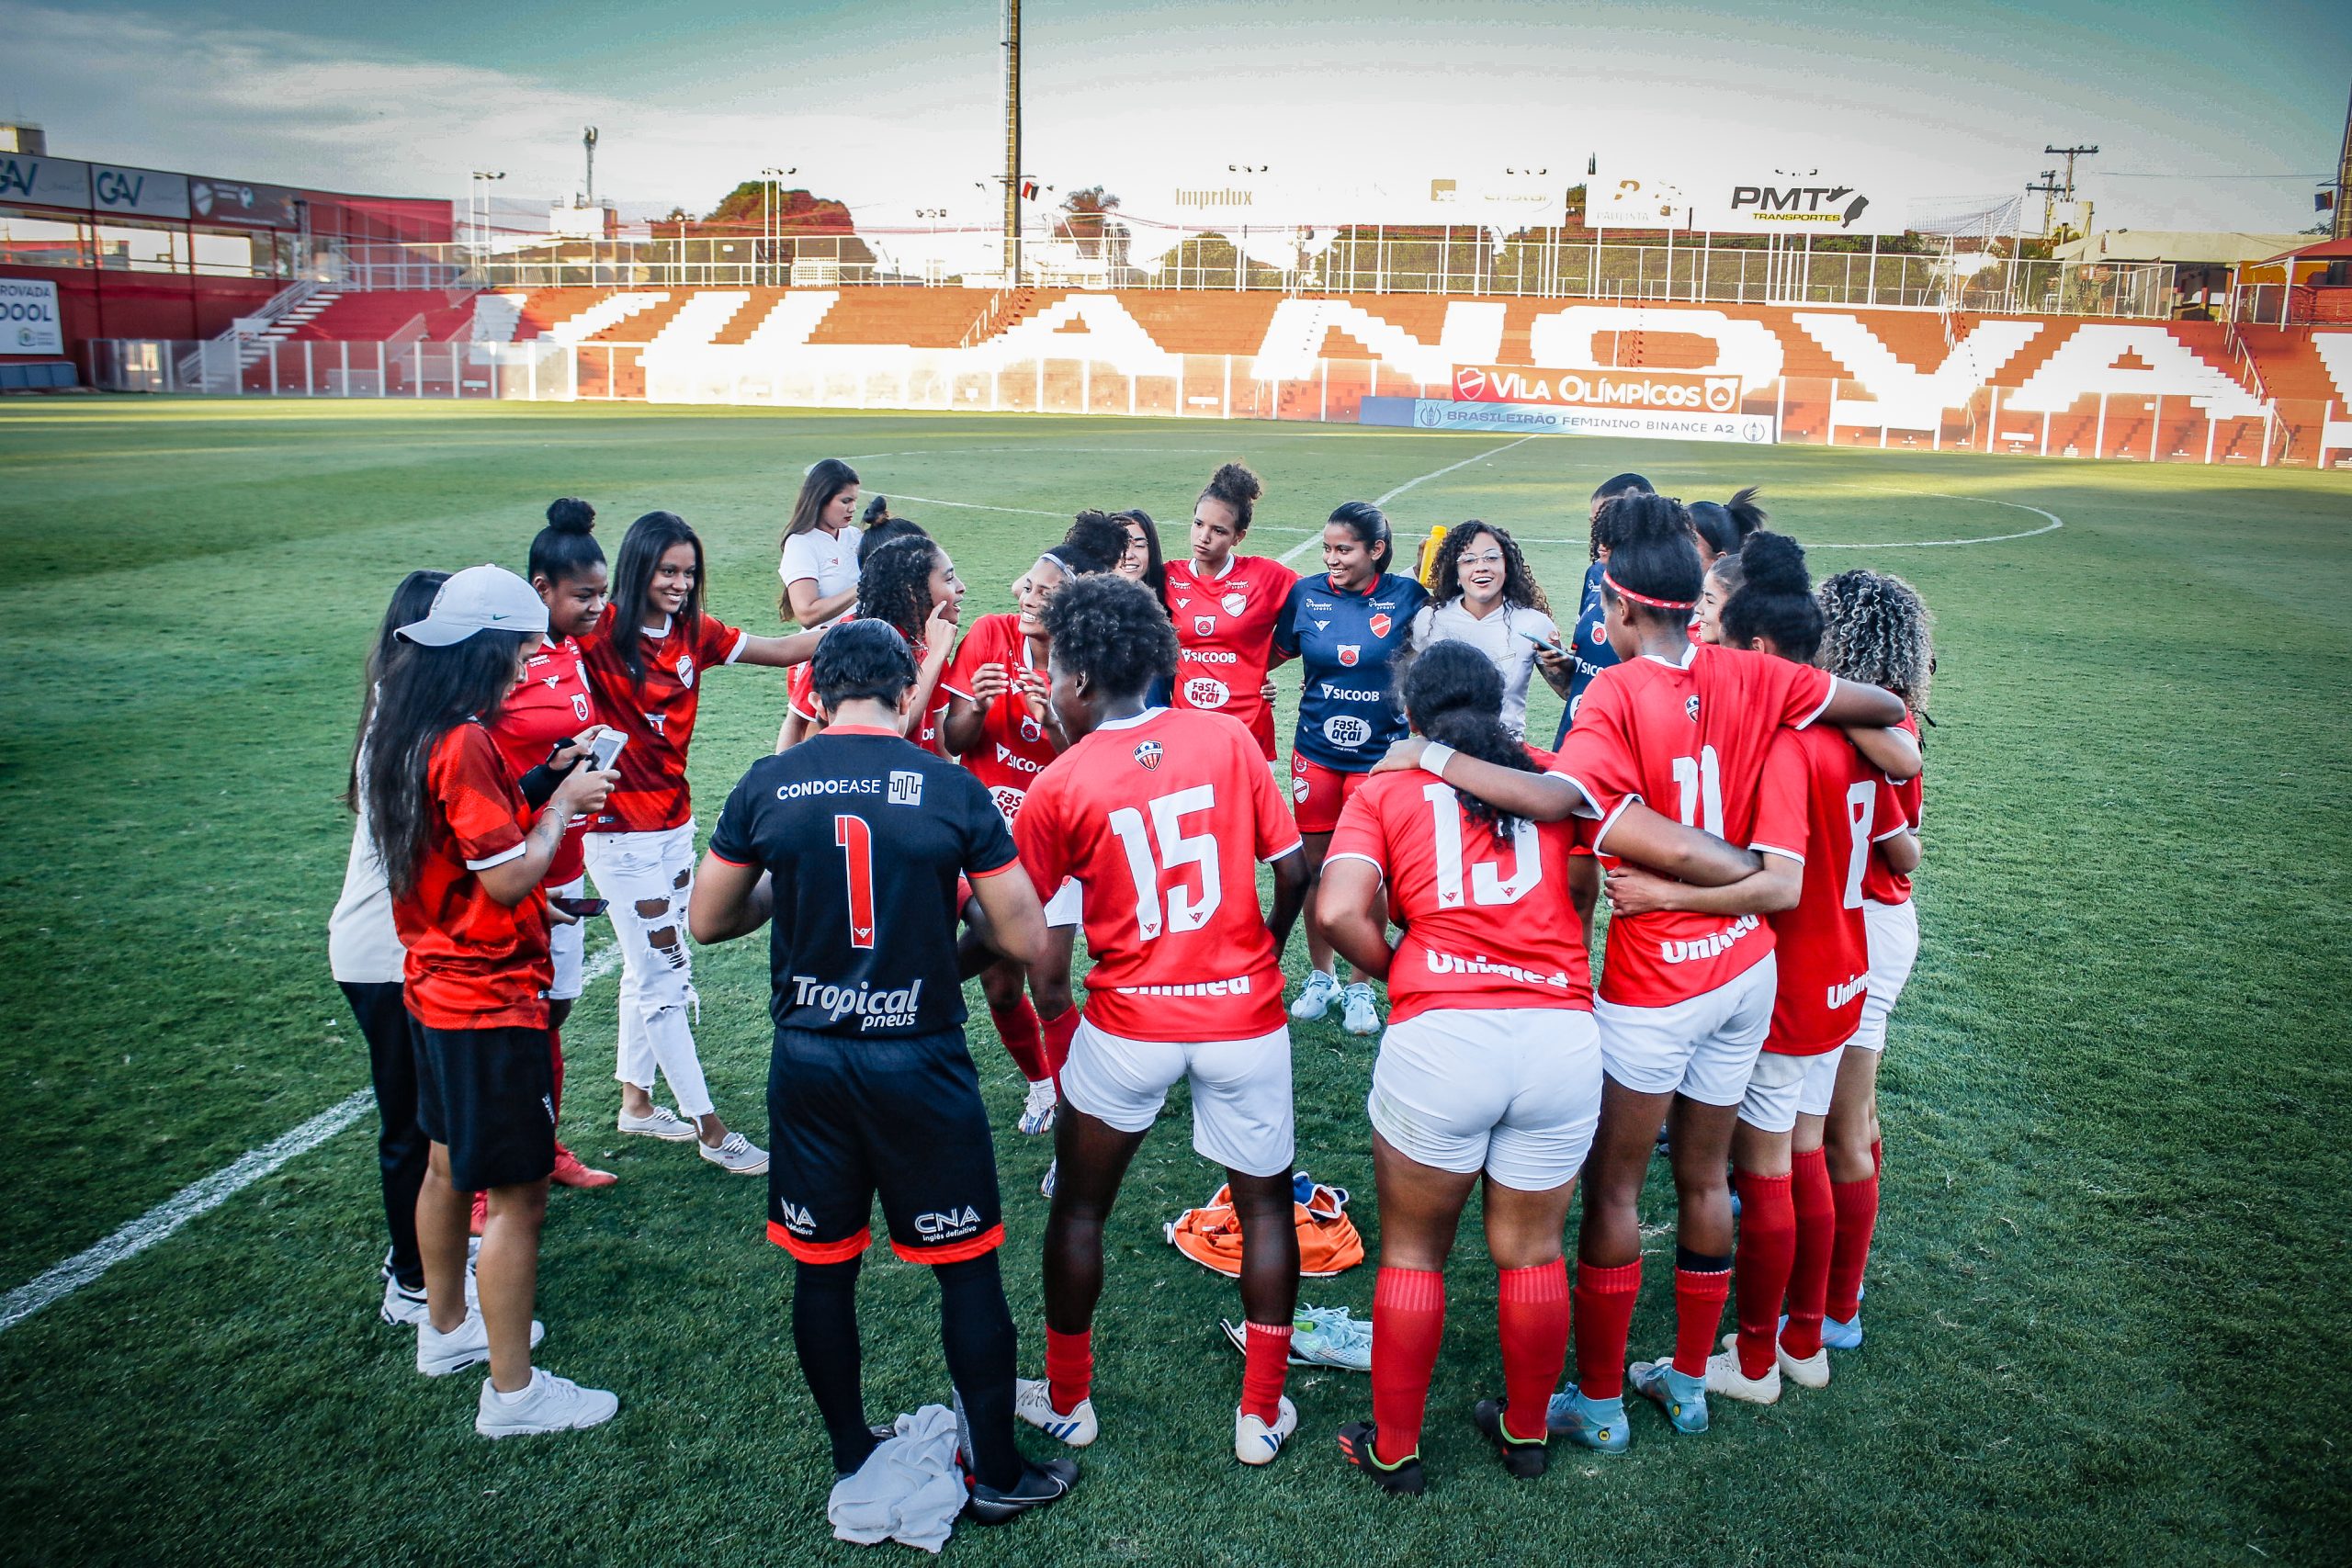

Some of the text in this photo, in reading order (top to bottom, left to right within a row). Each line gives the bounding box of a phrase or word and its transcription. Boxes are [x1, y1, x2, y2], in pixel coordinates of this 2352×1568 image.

[97, 172, 143, 207] GAV
[1731, 186, 1829, 211] PMT
[1752, 212, 1840, 221] TRANSPORTES
[1251, 298, 2269, 430] NOVA
[1490, 372, 1551, 400] VILA
[1447, 411, 1734, 434] BRASILEIRÃO FEMININO BINANCE A2
[1190, 651, 1237, 663] SICOOB
[1333, 689, 1380, 702] SICOOB
[776, 780, 881, 800] CONDOEASE
[1108, 784, 1222, 942] 15
[834, 814, 875, 950] 1
[793, 976, 922, 1022] Tropical
[861, 1013, 916, 1032] pneus
[915, 1205, 981, 1234] CNA
